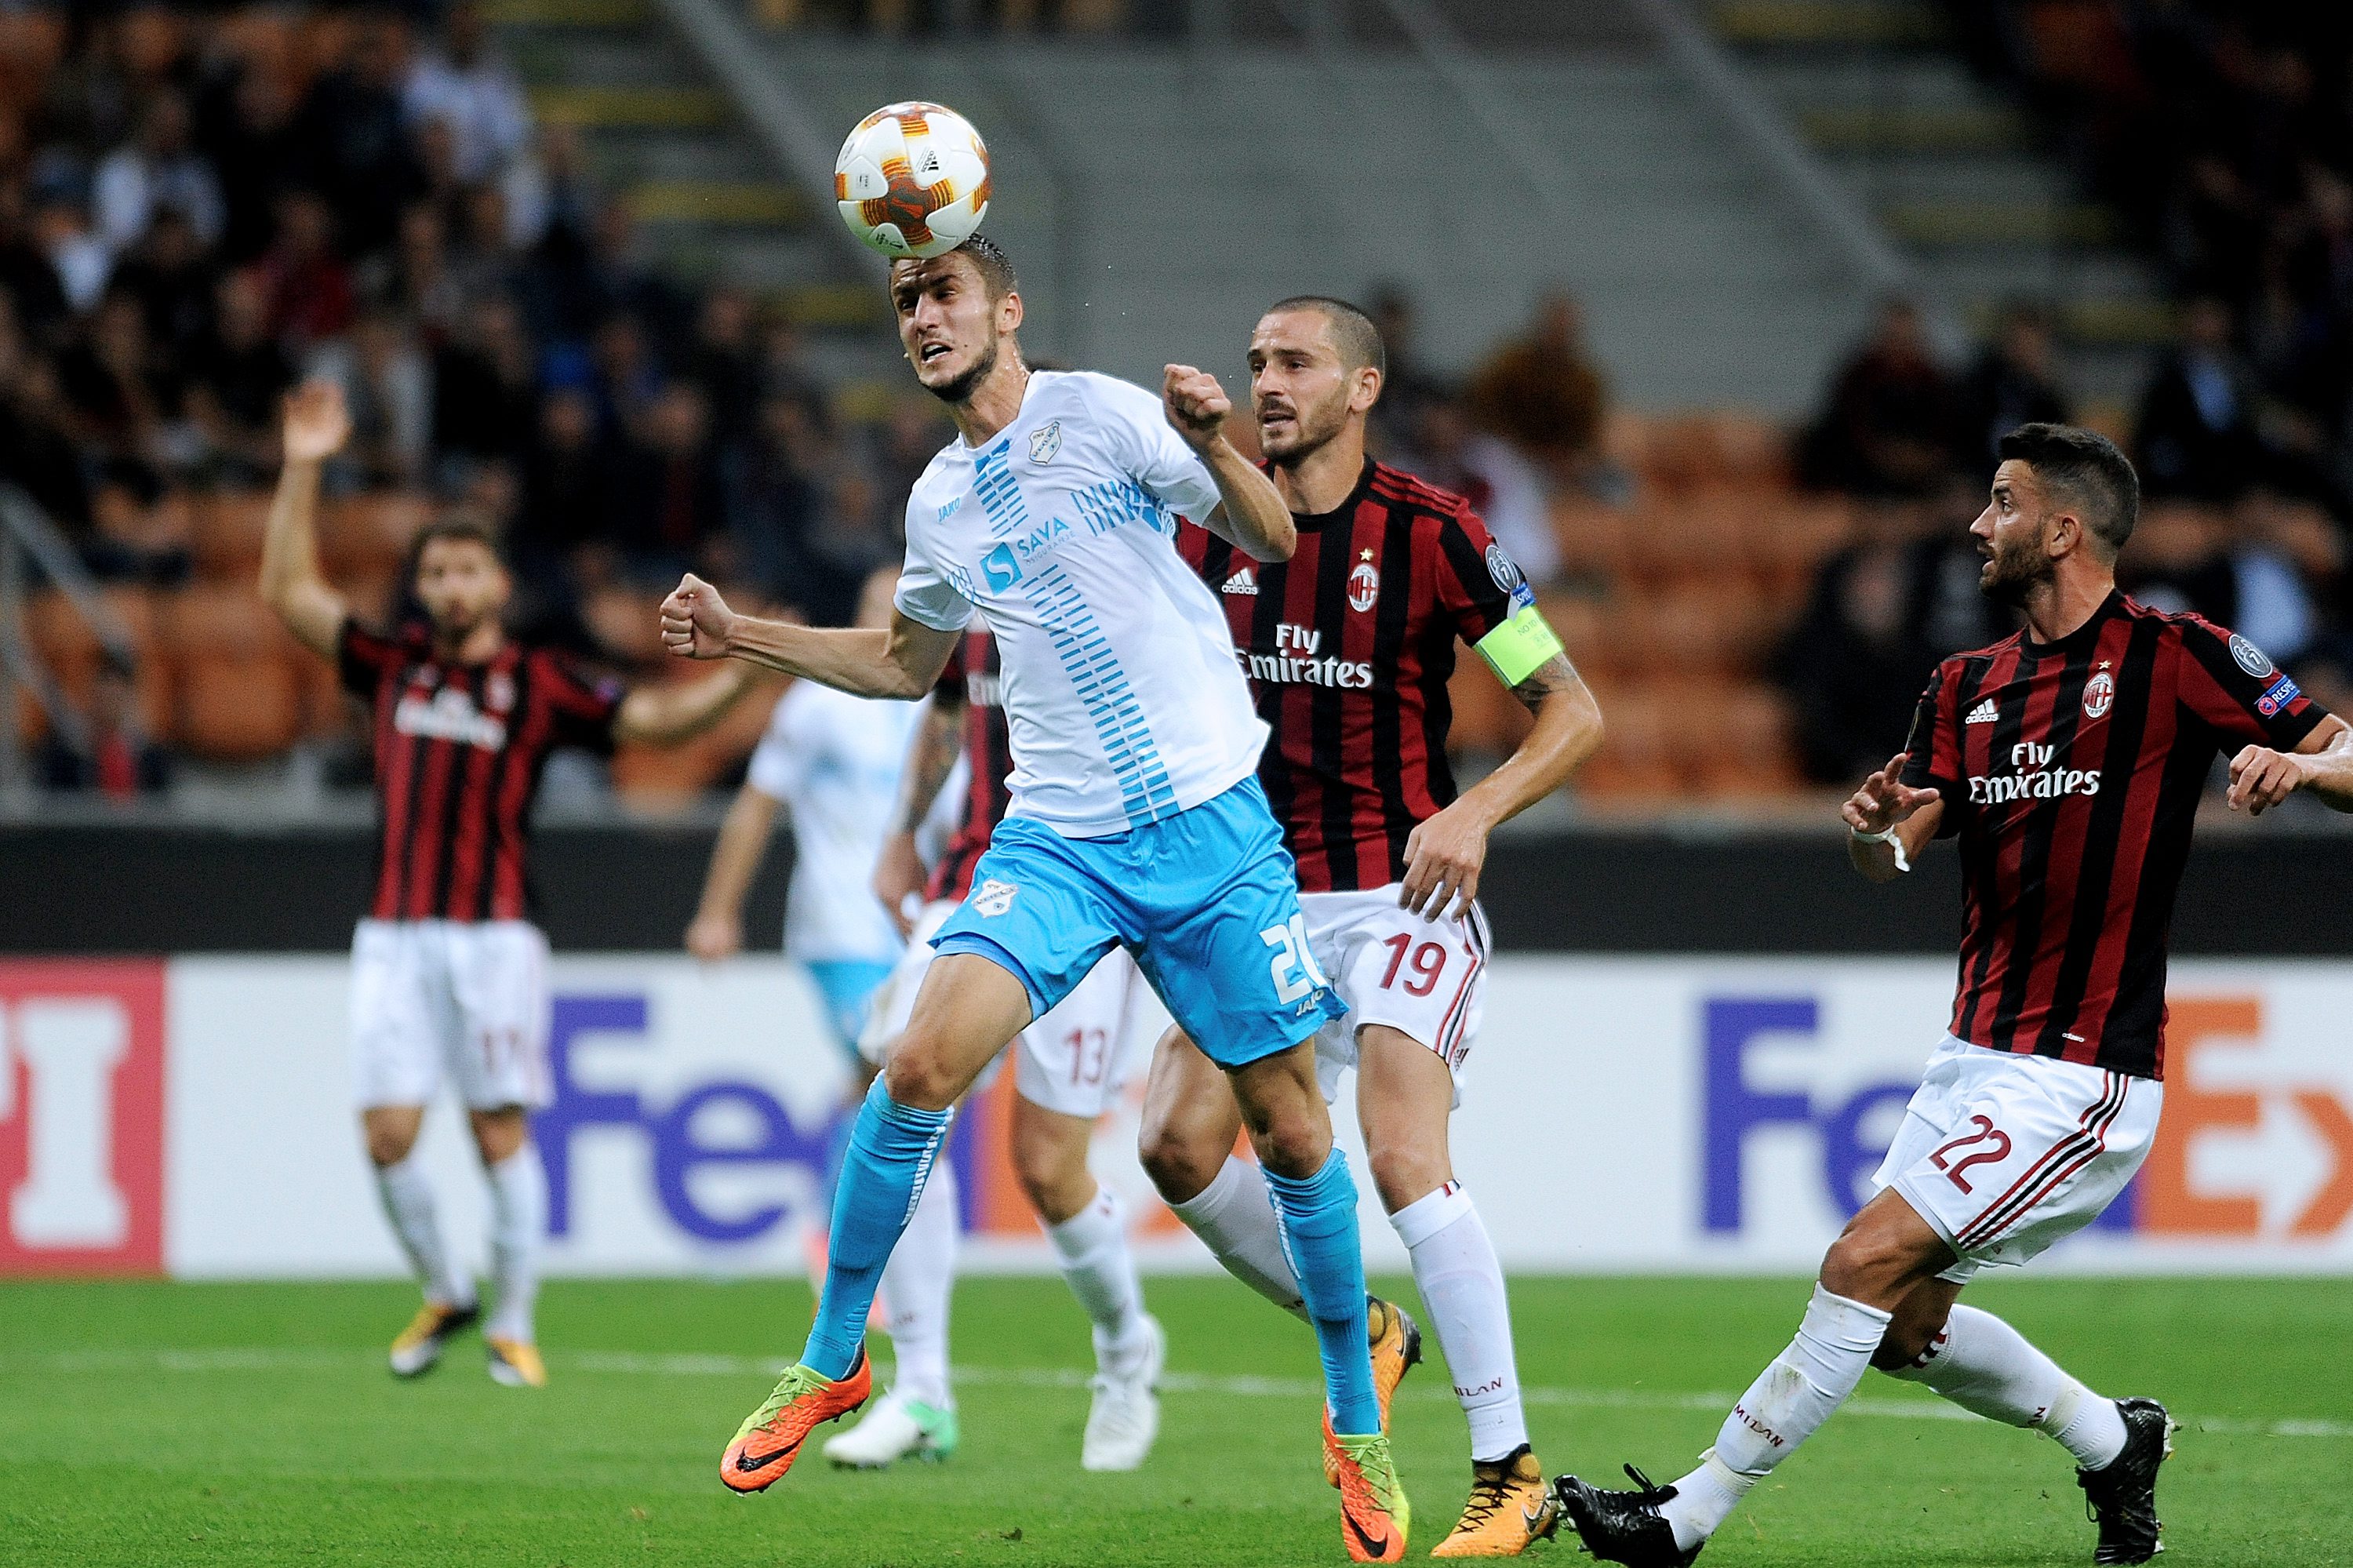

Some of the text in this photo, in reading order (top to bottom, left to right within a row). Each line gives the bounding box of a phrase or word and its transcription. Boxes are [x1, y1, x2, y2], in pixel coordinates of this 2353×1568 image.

[937, 497, 962, 522] JAKO
[1017, 517, 1070, 558] SAVA
[1221, 583, 1259, 596] adidas
[1275, 623, 1321, 655] Fly
[1965, 712, 1999, 725] adidas
[2011, 740, 2055, 769] Fly
[1967, 765, 2103, 805] Emirates
[1378, 932, 1447, 998] 19
[1062, 1028, 1106, 1086] 13
[1702, 995, 2353, 1239] FeE
[1928, 1114, 2012, 1195] 22
[1733, 1402, 1785, 1448] MILAN
